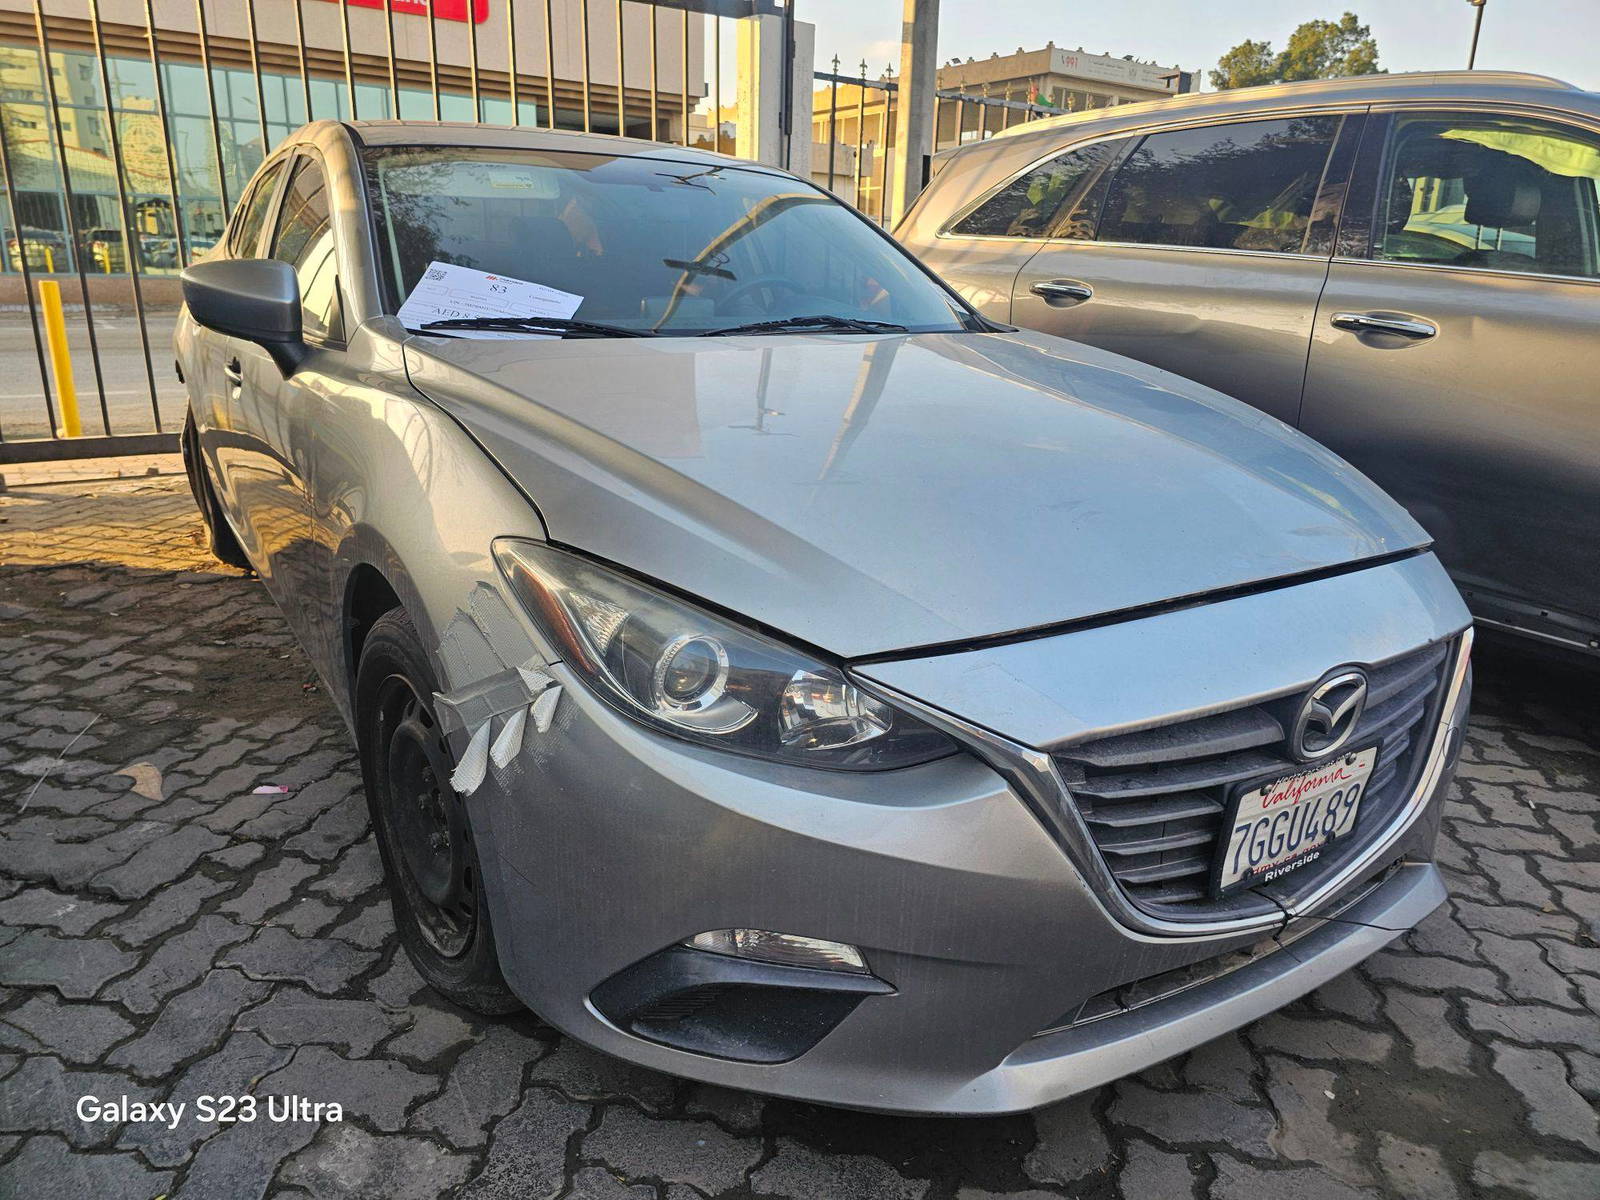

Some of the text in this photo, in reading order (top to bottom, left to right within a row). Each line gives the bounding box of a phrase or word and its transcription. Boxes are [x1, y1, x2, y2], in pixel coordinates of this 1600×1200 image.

[489, 283, 507, 294] 83
[1262, 767, 1352, 809] California
[1232, 783, 1361, 875] 7GGU489
[1264, 851, 1320, 882] Riverside
